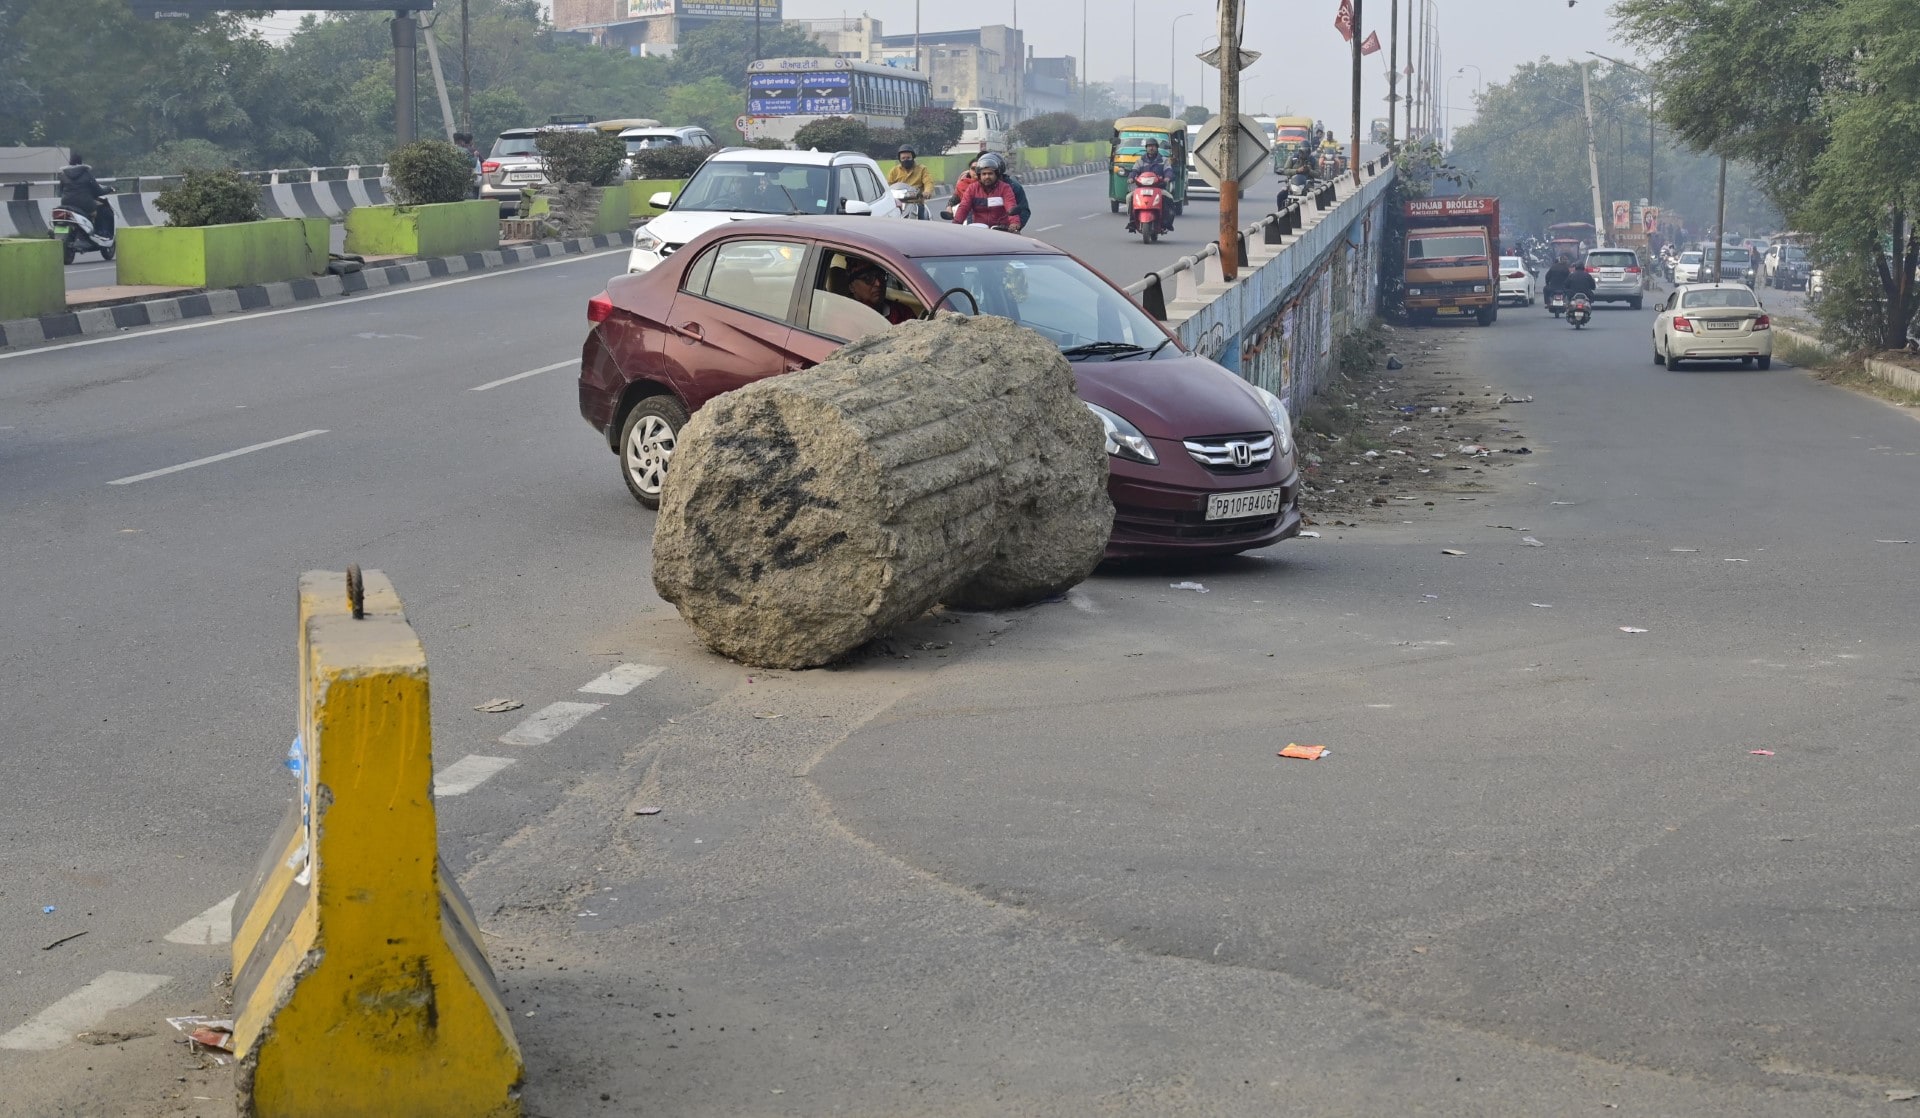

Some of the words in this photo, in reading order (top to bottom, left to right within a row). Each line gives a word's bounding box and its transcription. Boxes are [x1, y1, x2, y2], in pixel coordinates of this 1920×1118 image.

[1410, 201, 1443, 210] PUNJAB
[1446, 199, 1485, 209] BROILERS
[1216, 494, 1279, 515] PB10FB4067
